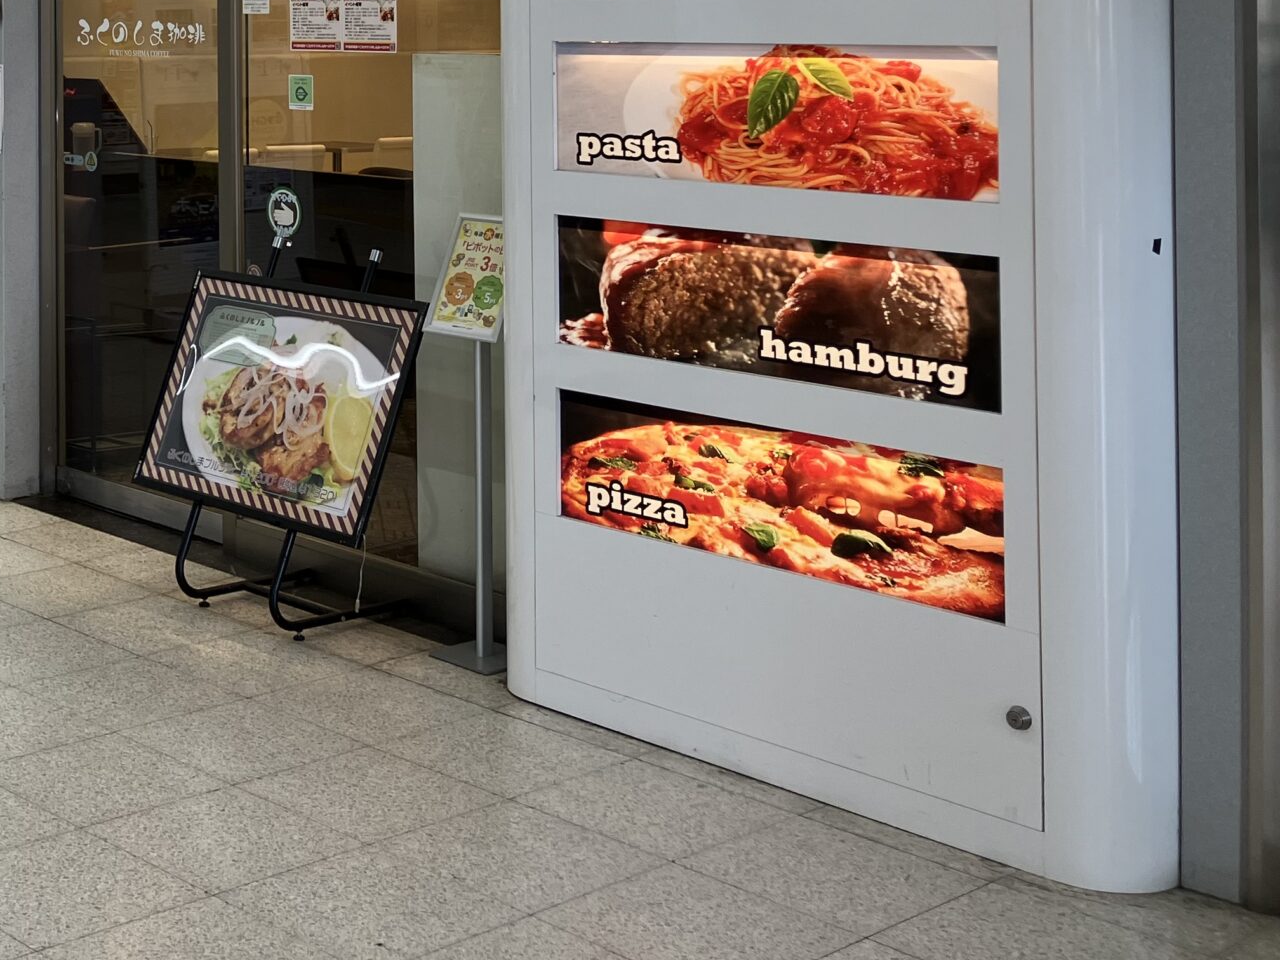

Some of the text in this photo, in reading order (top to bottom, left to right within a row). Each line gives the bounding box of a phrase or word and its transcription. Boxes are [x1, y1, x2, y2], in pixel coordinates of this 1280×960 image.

[77, 18, 206, 46] ふくのしま珈琲
[578, 131, 681, 163] pasta
[759, 328, 969, 397] hamburg
[587, 481, 687, 527] pizza
